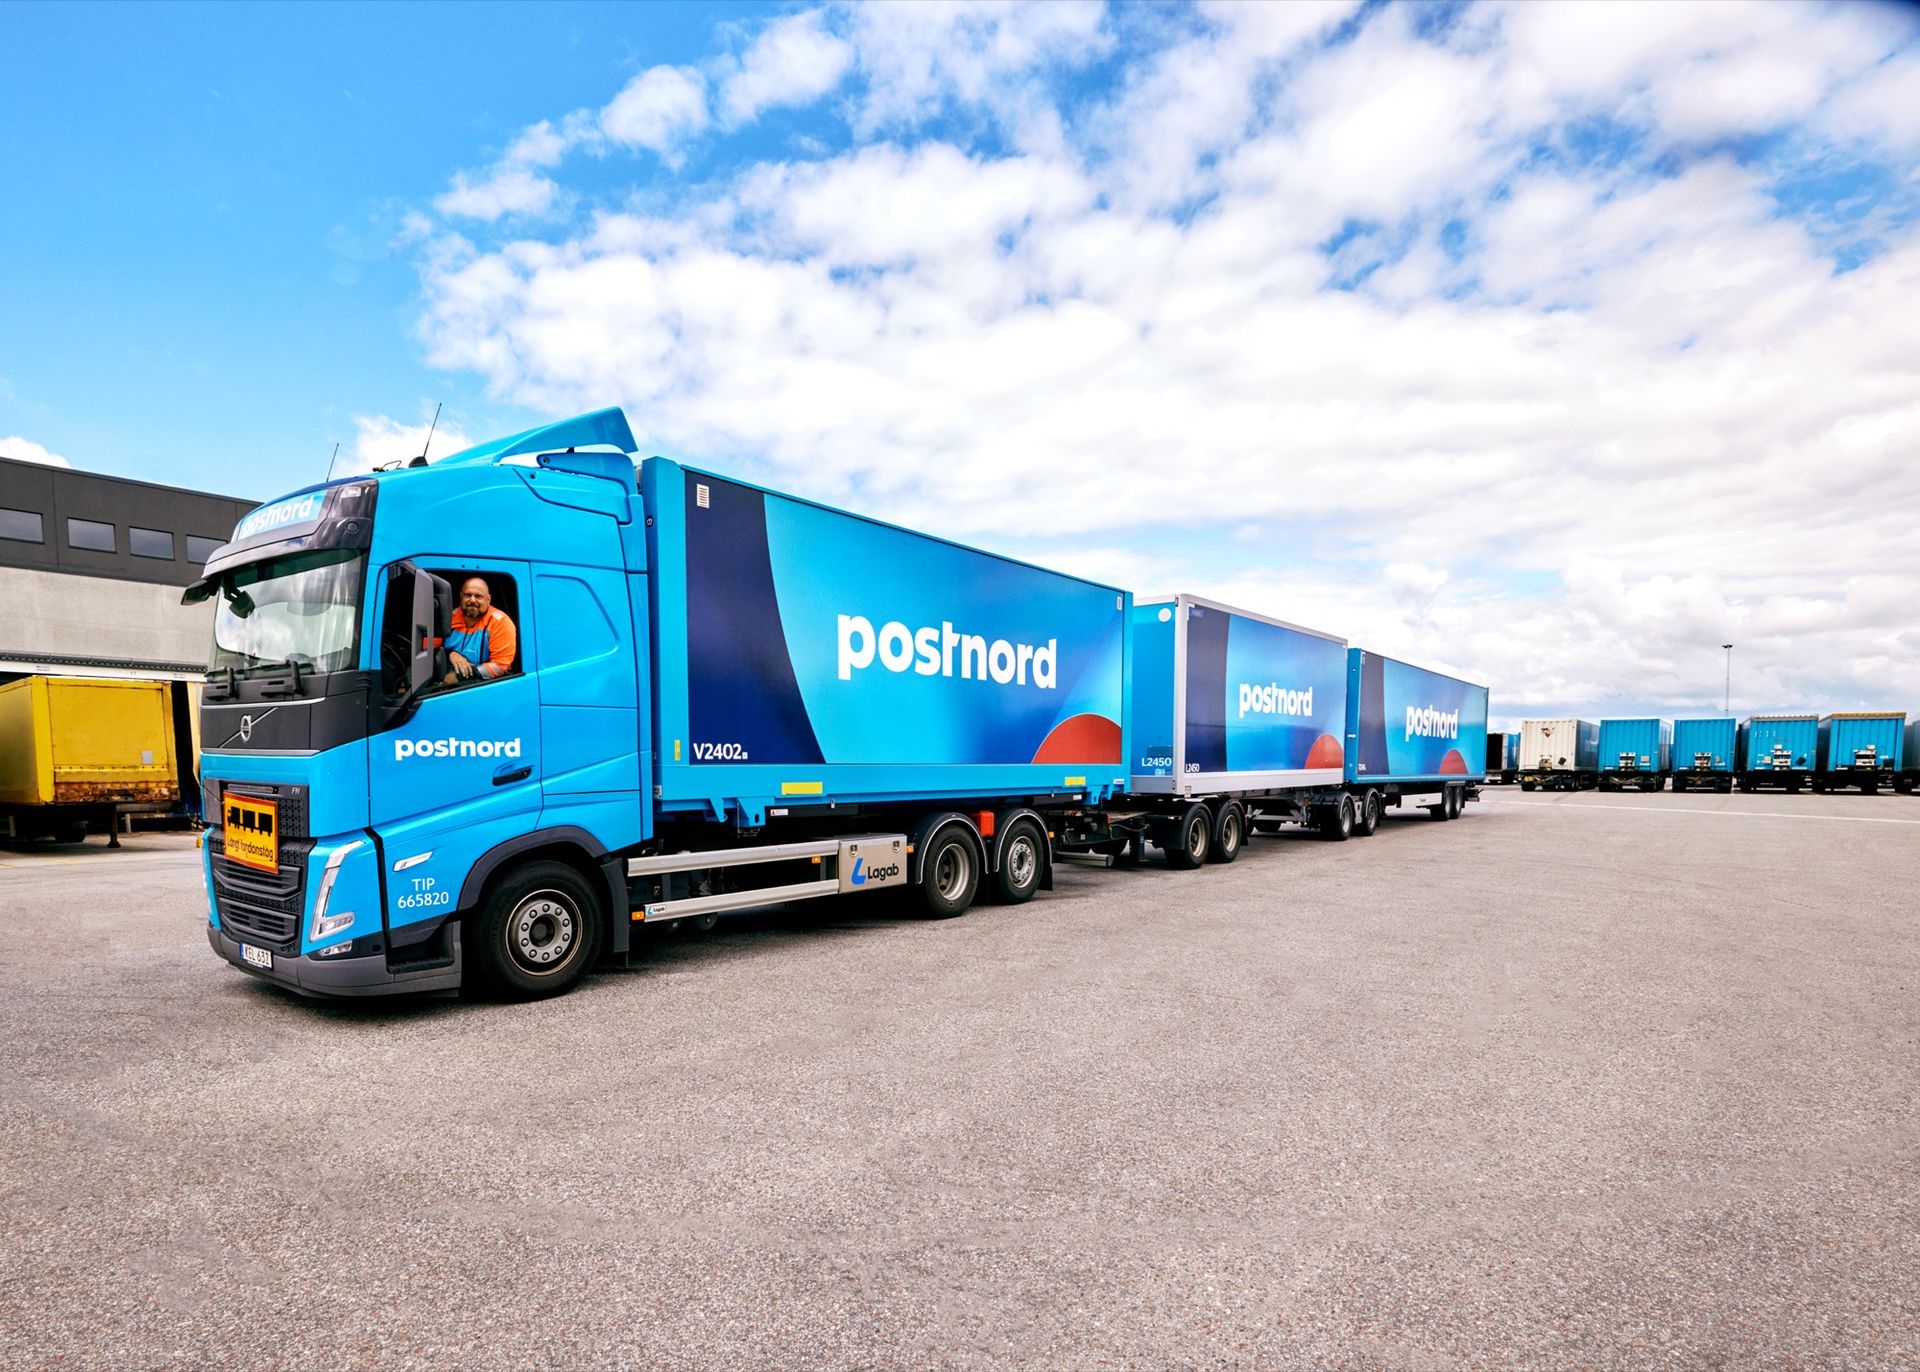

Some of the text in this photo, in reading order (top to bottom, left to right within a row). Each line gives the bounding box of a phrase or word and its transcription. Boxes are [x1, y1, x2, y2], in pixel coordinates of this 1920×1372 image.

[244, 495, 314, 533] postnord
[837, 614, 1057, 689] postnord
[1239, 682, 1313, 719] postnord
[1405, 704, 1458, 742] postnord
[395, 737, 521, 761] postnord
[693, 742, 742, 760] V2402
[1141, 757, 1172, 767] L2450
[291, 787, 301, 795] FH
[867, 863, 900, 881] Lagab
[411, 877, 436, 892] TIP
[397, 891, 450, 909] 665820
